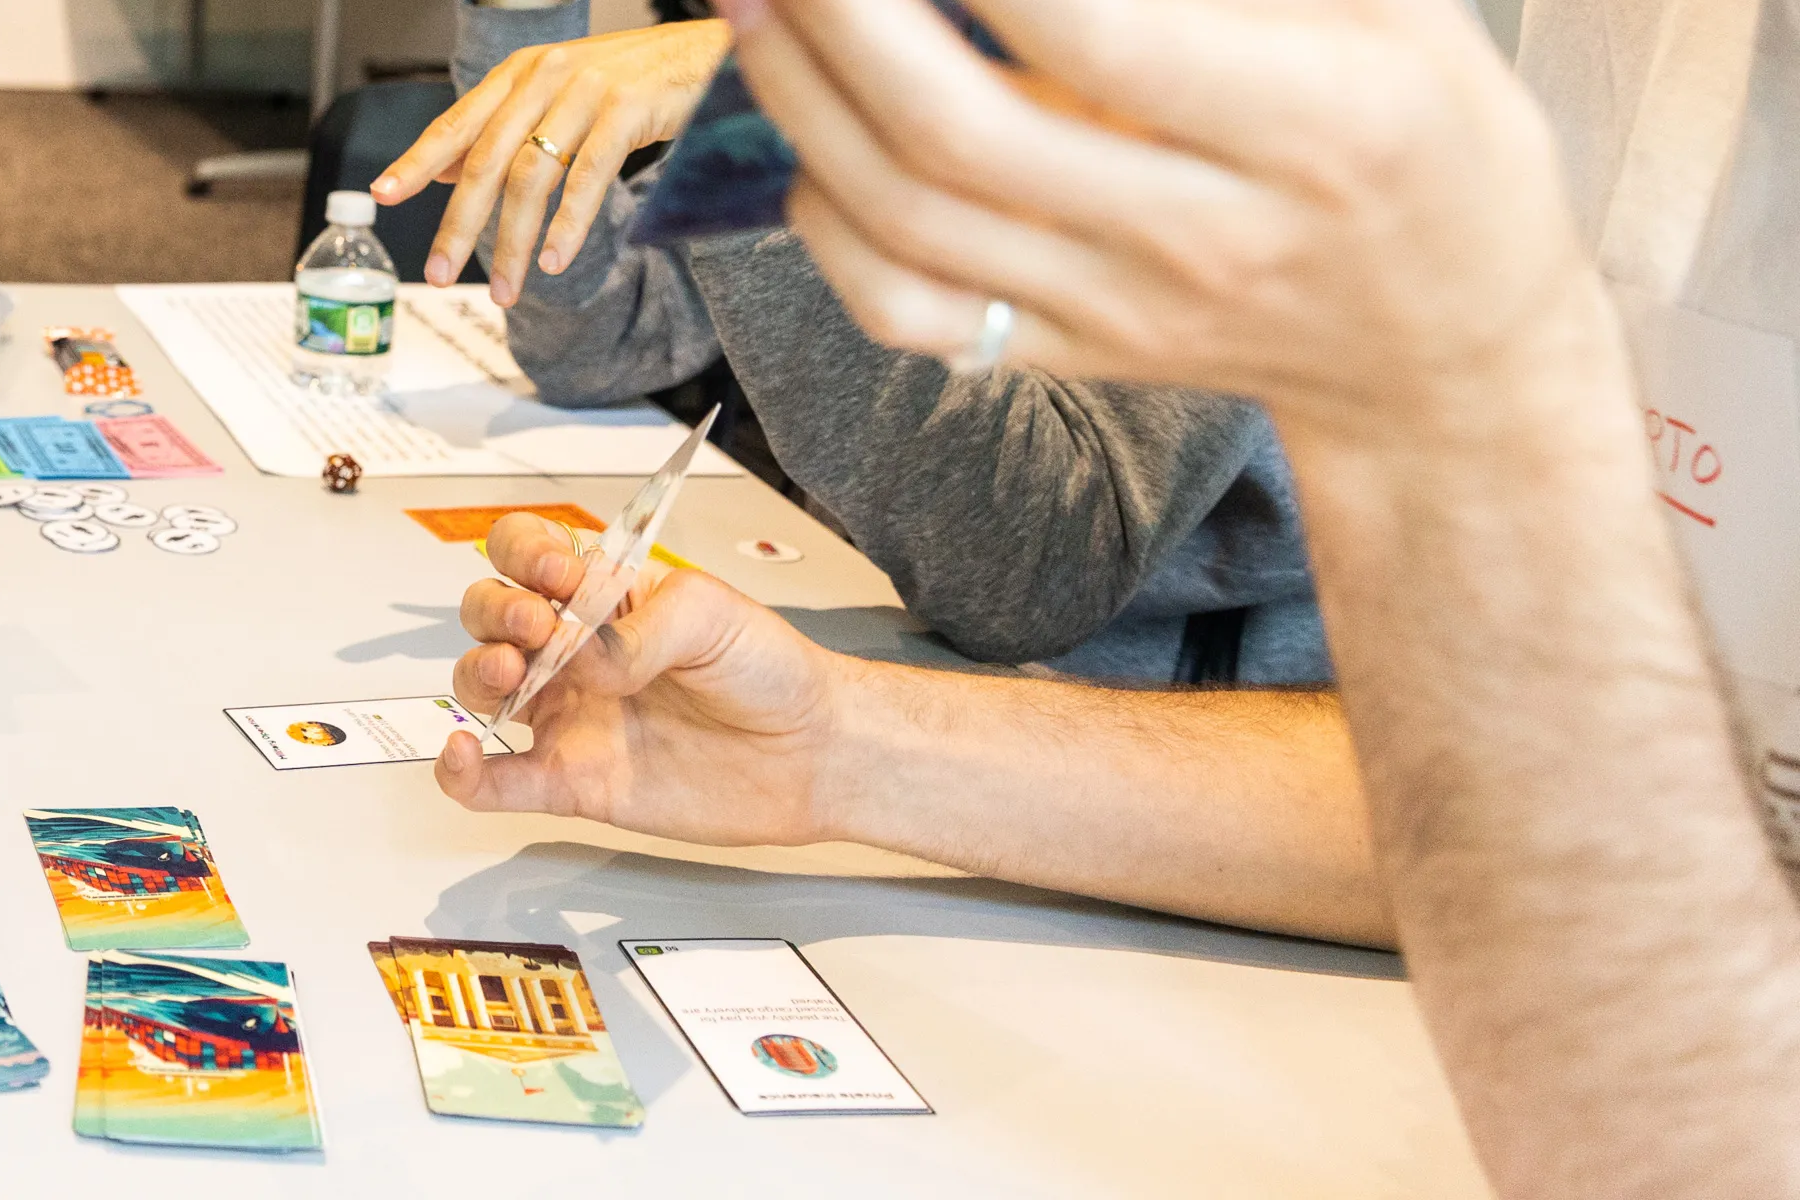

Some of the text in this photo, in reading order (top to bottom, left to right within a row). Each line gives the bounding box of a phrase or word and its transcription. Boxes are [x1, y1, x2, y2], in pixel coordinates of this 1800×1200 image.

[705, 1007, 755, 1015] delivery
[772, 1014, 819, 1022] penalty
[840, 1092, 895, 1100] Private
